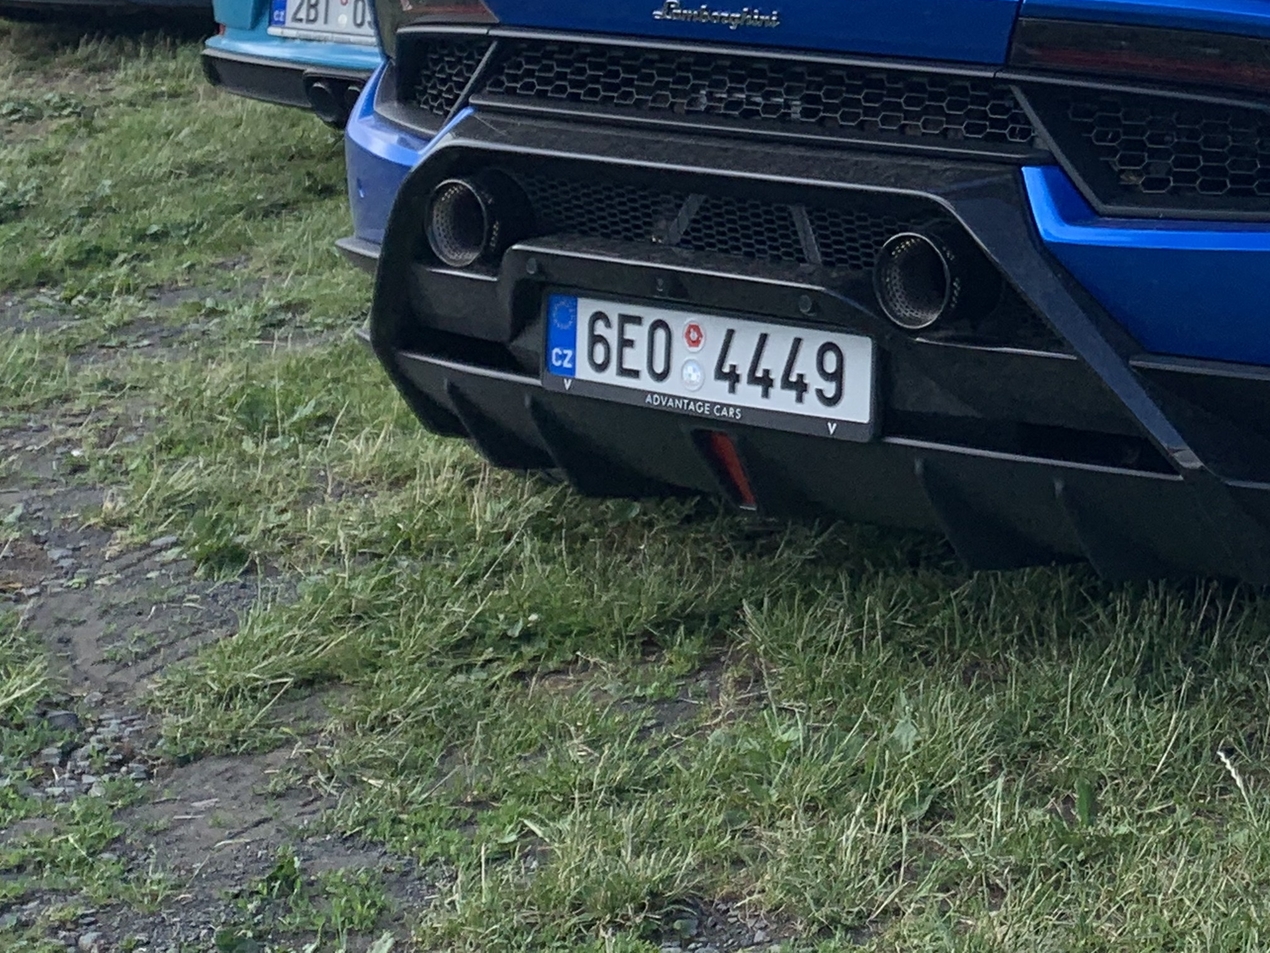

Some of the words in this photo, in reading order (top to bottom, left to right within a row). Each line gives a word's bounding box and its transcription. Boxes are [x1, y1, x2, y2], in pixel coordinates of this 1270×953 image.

[273, 10, 285, 21] CZ
[551, 348, 573, 369] CZ
[713, 328, 844, 408] 4449
[645, 394, 711, 416] ADVANTAGE
[713, 405, 742, 420] CARS
